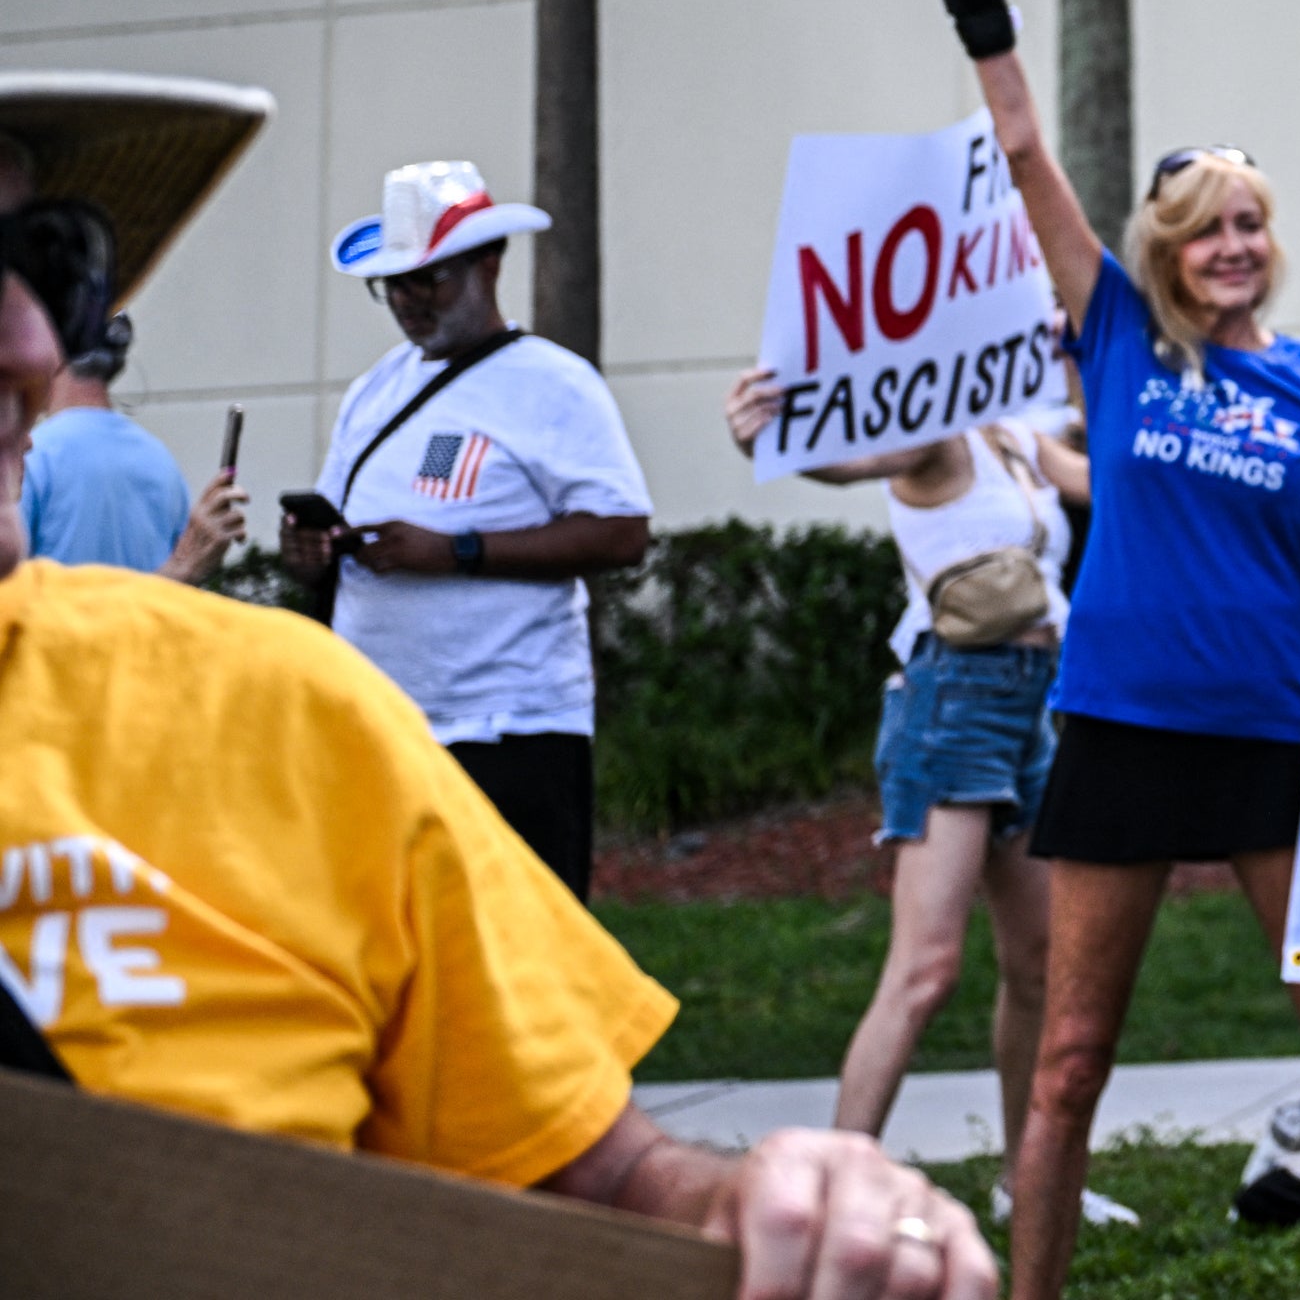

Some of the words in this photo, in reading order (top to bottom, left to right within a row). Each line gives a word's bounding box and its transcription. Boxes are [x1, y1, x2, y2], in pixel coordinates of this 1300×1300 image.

[797, 203, 943, 375] NO
[947, 208, 1042, 300] KIN
[777, 318, 1052, 456] FASCISTS
[1132, 428, 1183, 464] NO
[1185, 443, 1287, 493] KINGS
[0, 905, 188, 1030] VE
